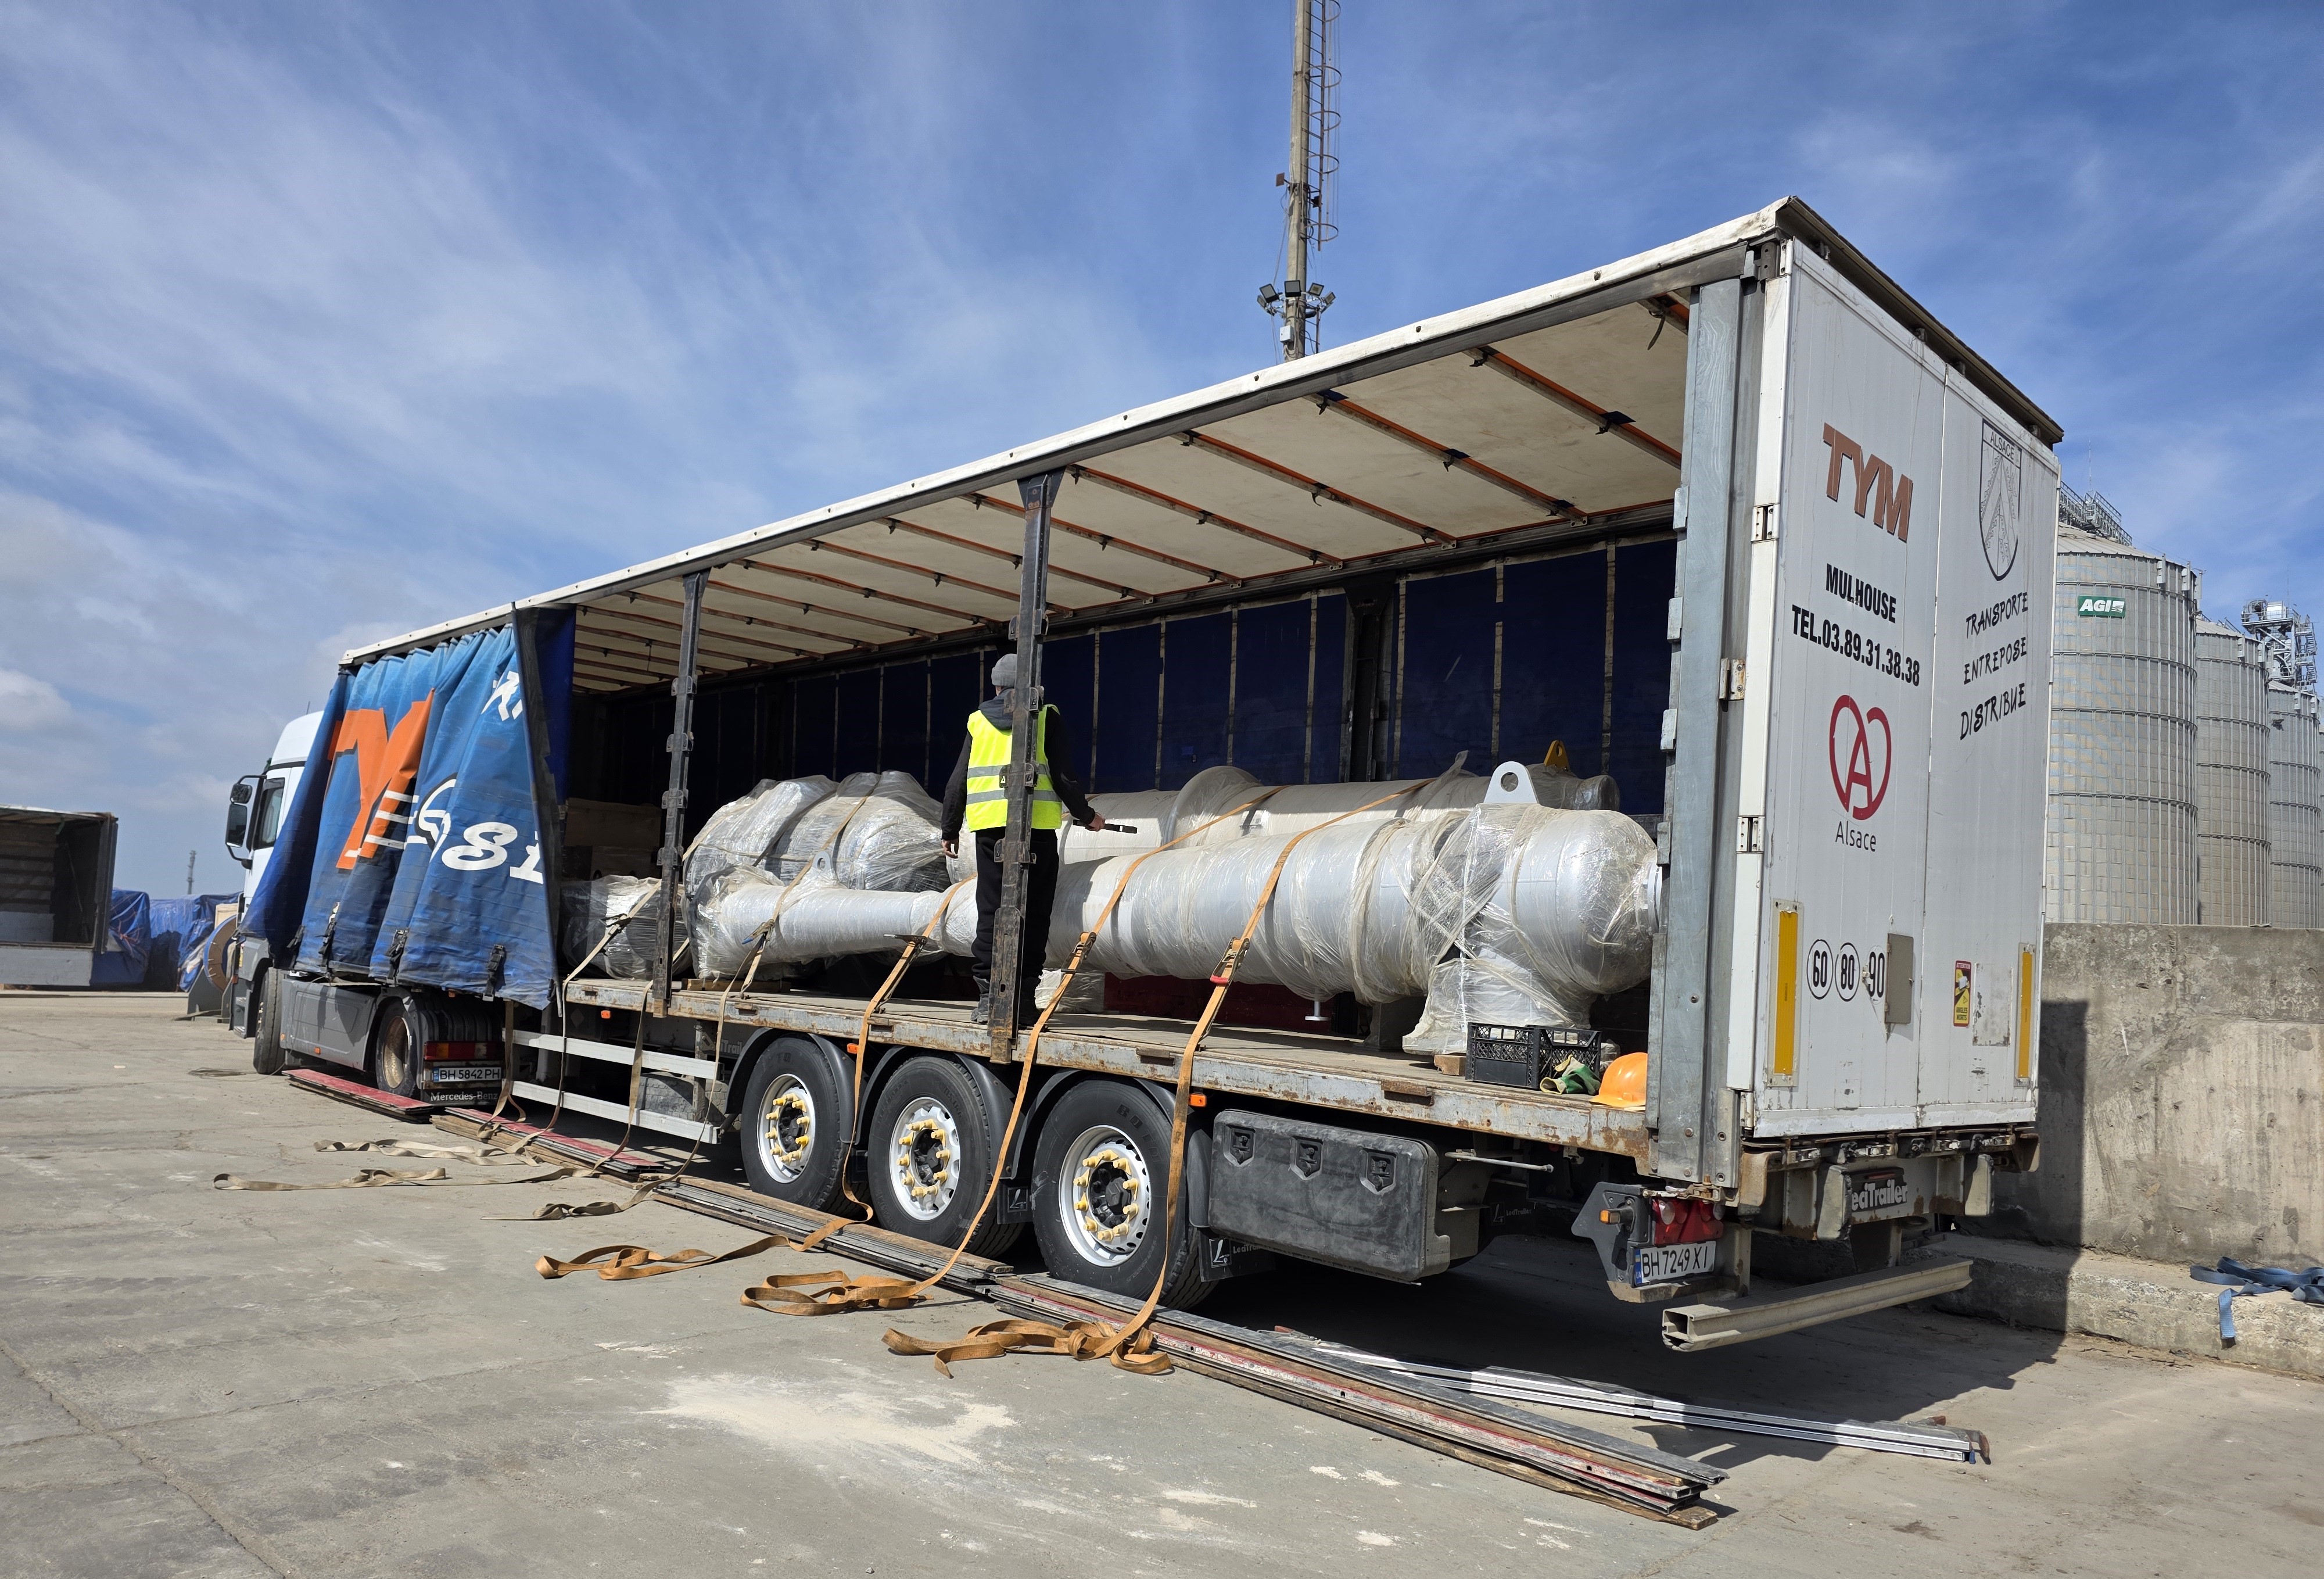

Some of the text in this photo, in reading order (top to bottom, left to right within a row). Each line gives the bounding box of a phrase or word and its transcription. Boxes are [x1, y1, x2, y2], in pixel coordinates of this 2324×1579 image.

[1990, 431, 2014, 461] ALSACE
[1823, 423, 1913, 543] TYM
[1826, 563, 1896, 623] MULHOUSE
[2079, 599, 2112, 613] AGI
[1966, 592, 2028, 639] TRANSPORTE
[1792, 605, 1920, 686] TEL.03.89.31.38.38
[1964, 636, 2027, 685] ENTREPOSE
[1960, 682, 2027, 740] DISTRIBUE
[1835, 820, 1877, 852] Alsace
[1813, 950, 1828, 988] 60
[1841, 953, 1855, 991] 80
[1868, 951, 1885, 998] 90
[440, 1070, 456, 1080] BH
[458, 1069, 483, 1079] 5842
[485, 1069, 500, 1079] PH
[431, 1091, 498, 1101] Mercedes-Benz
[1852, 1179, 1908, 1211] eciTrailer
[1642, 1251, 1660, 1278] BH
[1662, 1248, 1690, 1275] 7249
[1692, 1246, 1708, 1270] XI
